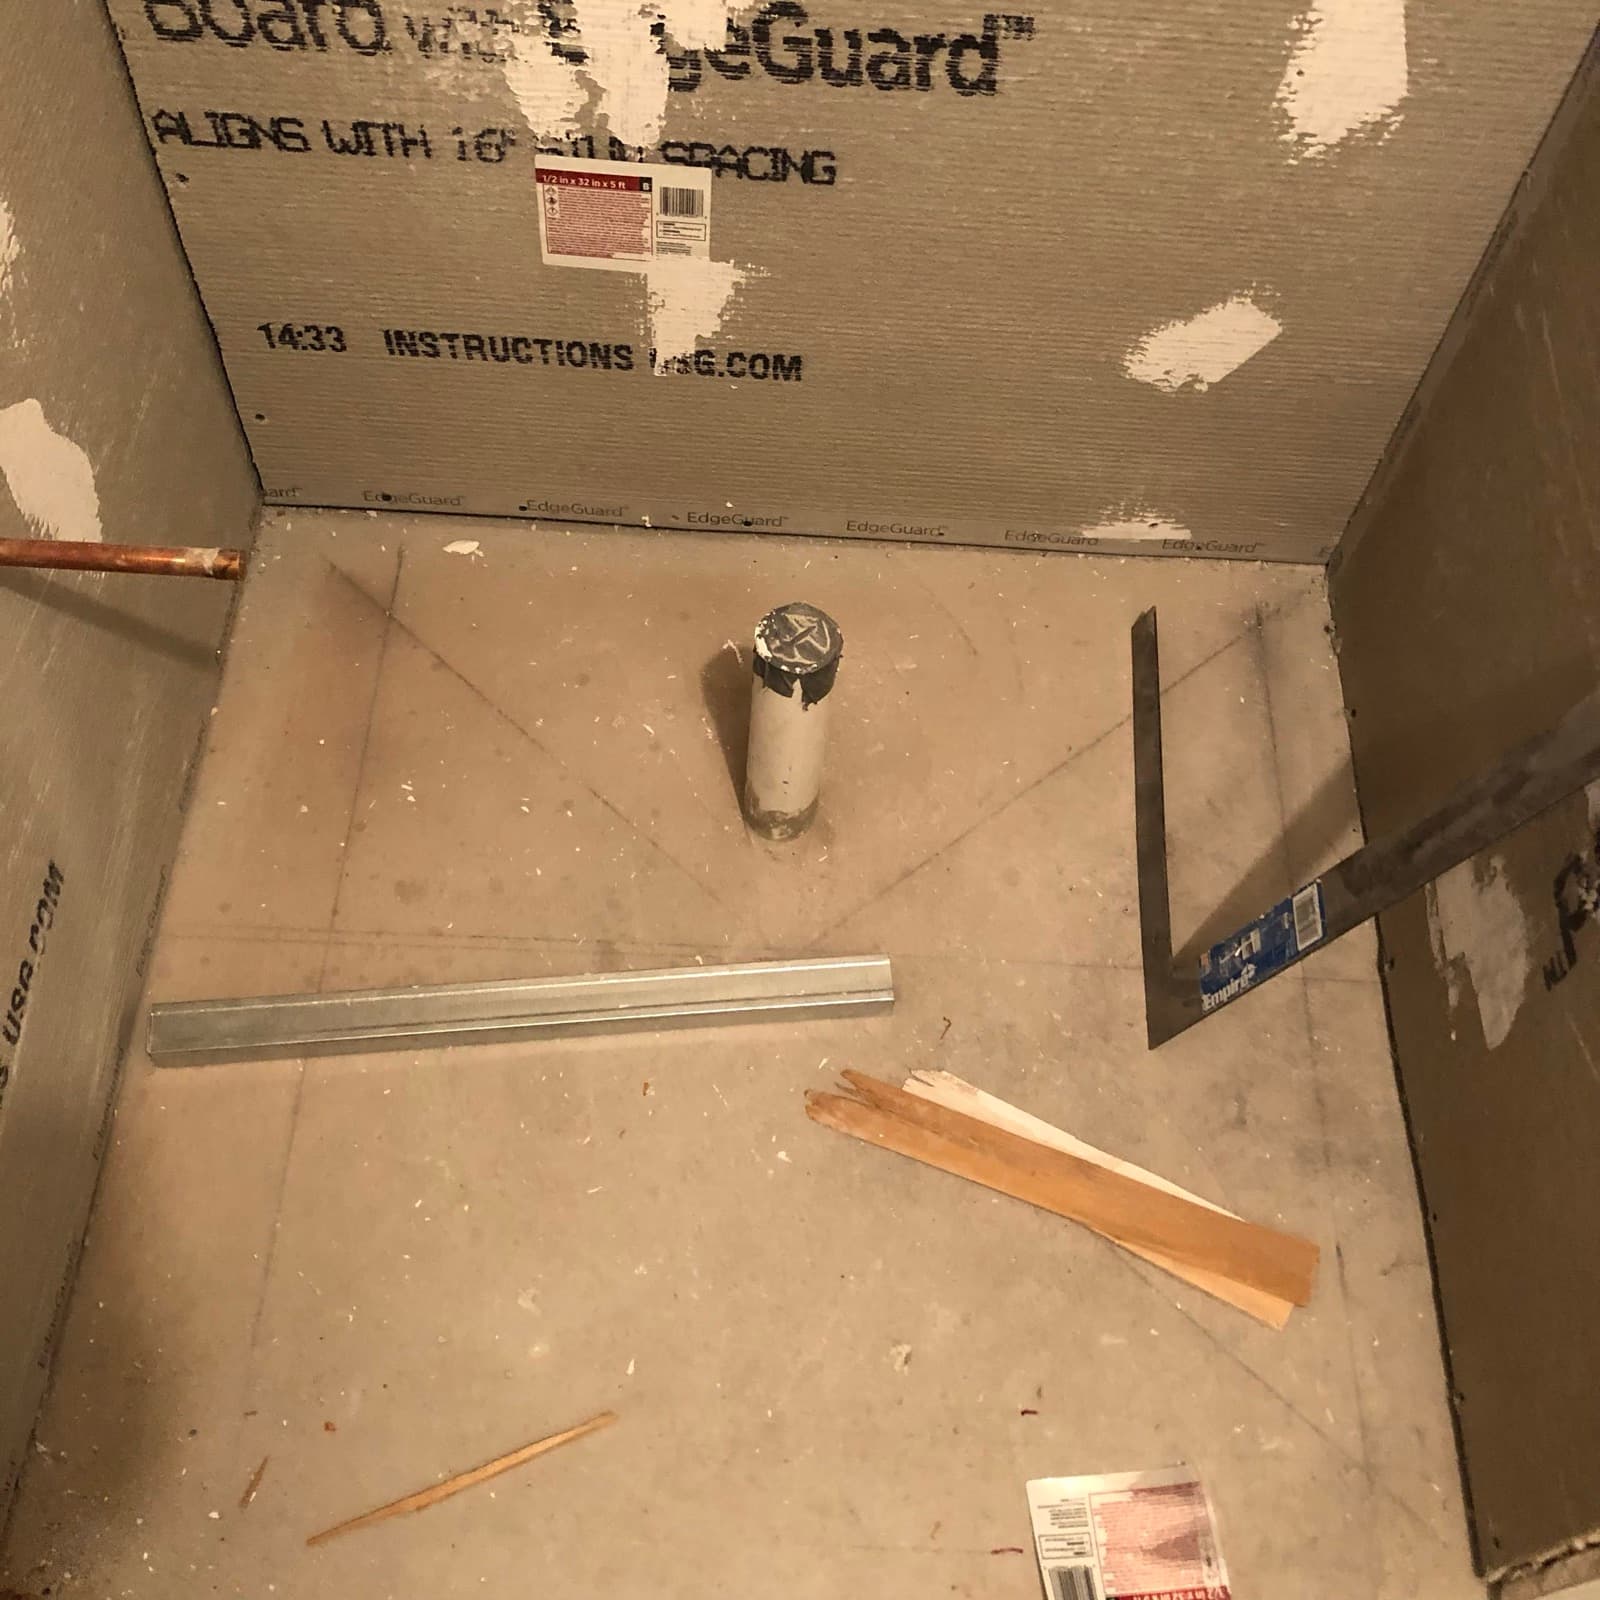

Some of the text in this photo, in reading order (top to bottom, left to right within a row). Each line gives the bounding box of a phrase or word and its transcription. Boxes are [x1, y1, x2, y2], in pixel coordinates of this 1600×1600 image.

[151, 108, 312, 153] ALIGNS
[321, 118, 432, 159] WITH
[543, 174, 558, 184] 1/2
[560, 176, 569, 185] in
[570, 178, 577, 186] x
[578, 178, 590, 187] 32
[592, 180, 601, 188] in
[610, 181, 617, 190] 5
[618, 181, 626, 191] ft
[642, 183, 651, 192] B
[257, 322, 347, 353] 14:33
[383, 328, 634, 371] INSTRUCTIONS
[526, 499, 625, 518] EdgeGuard
